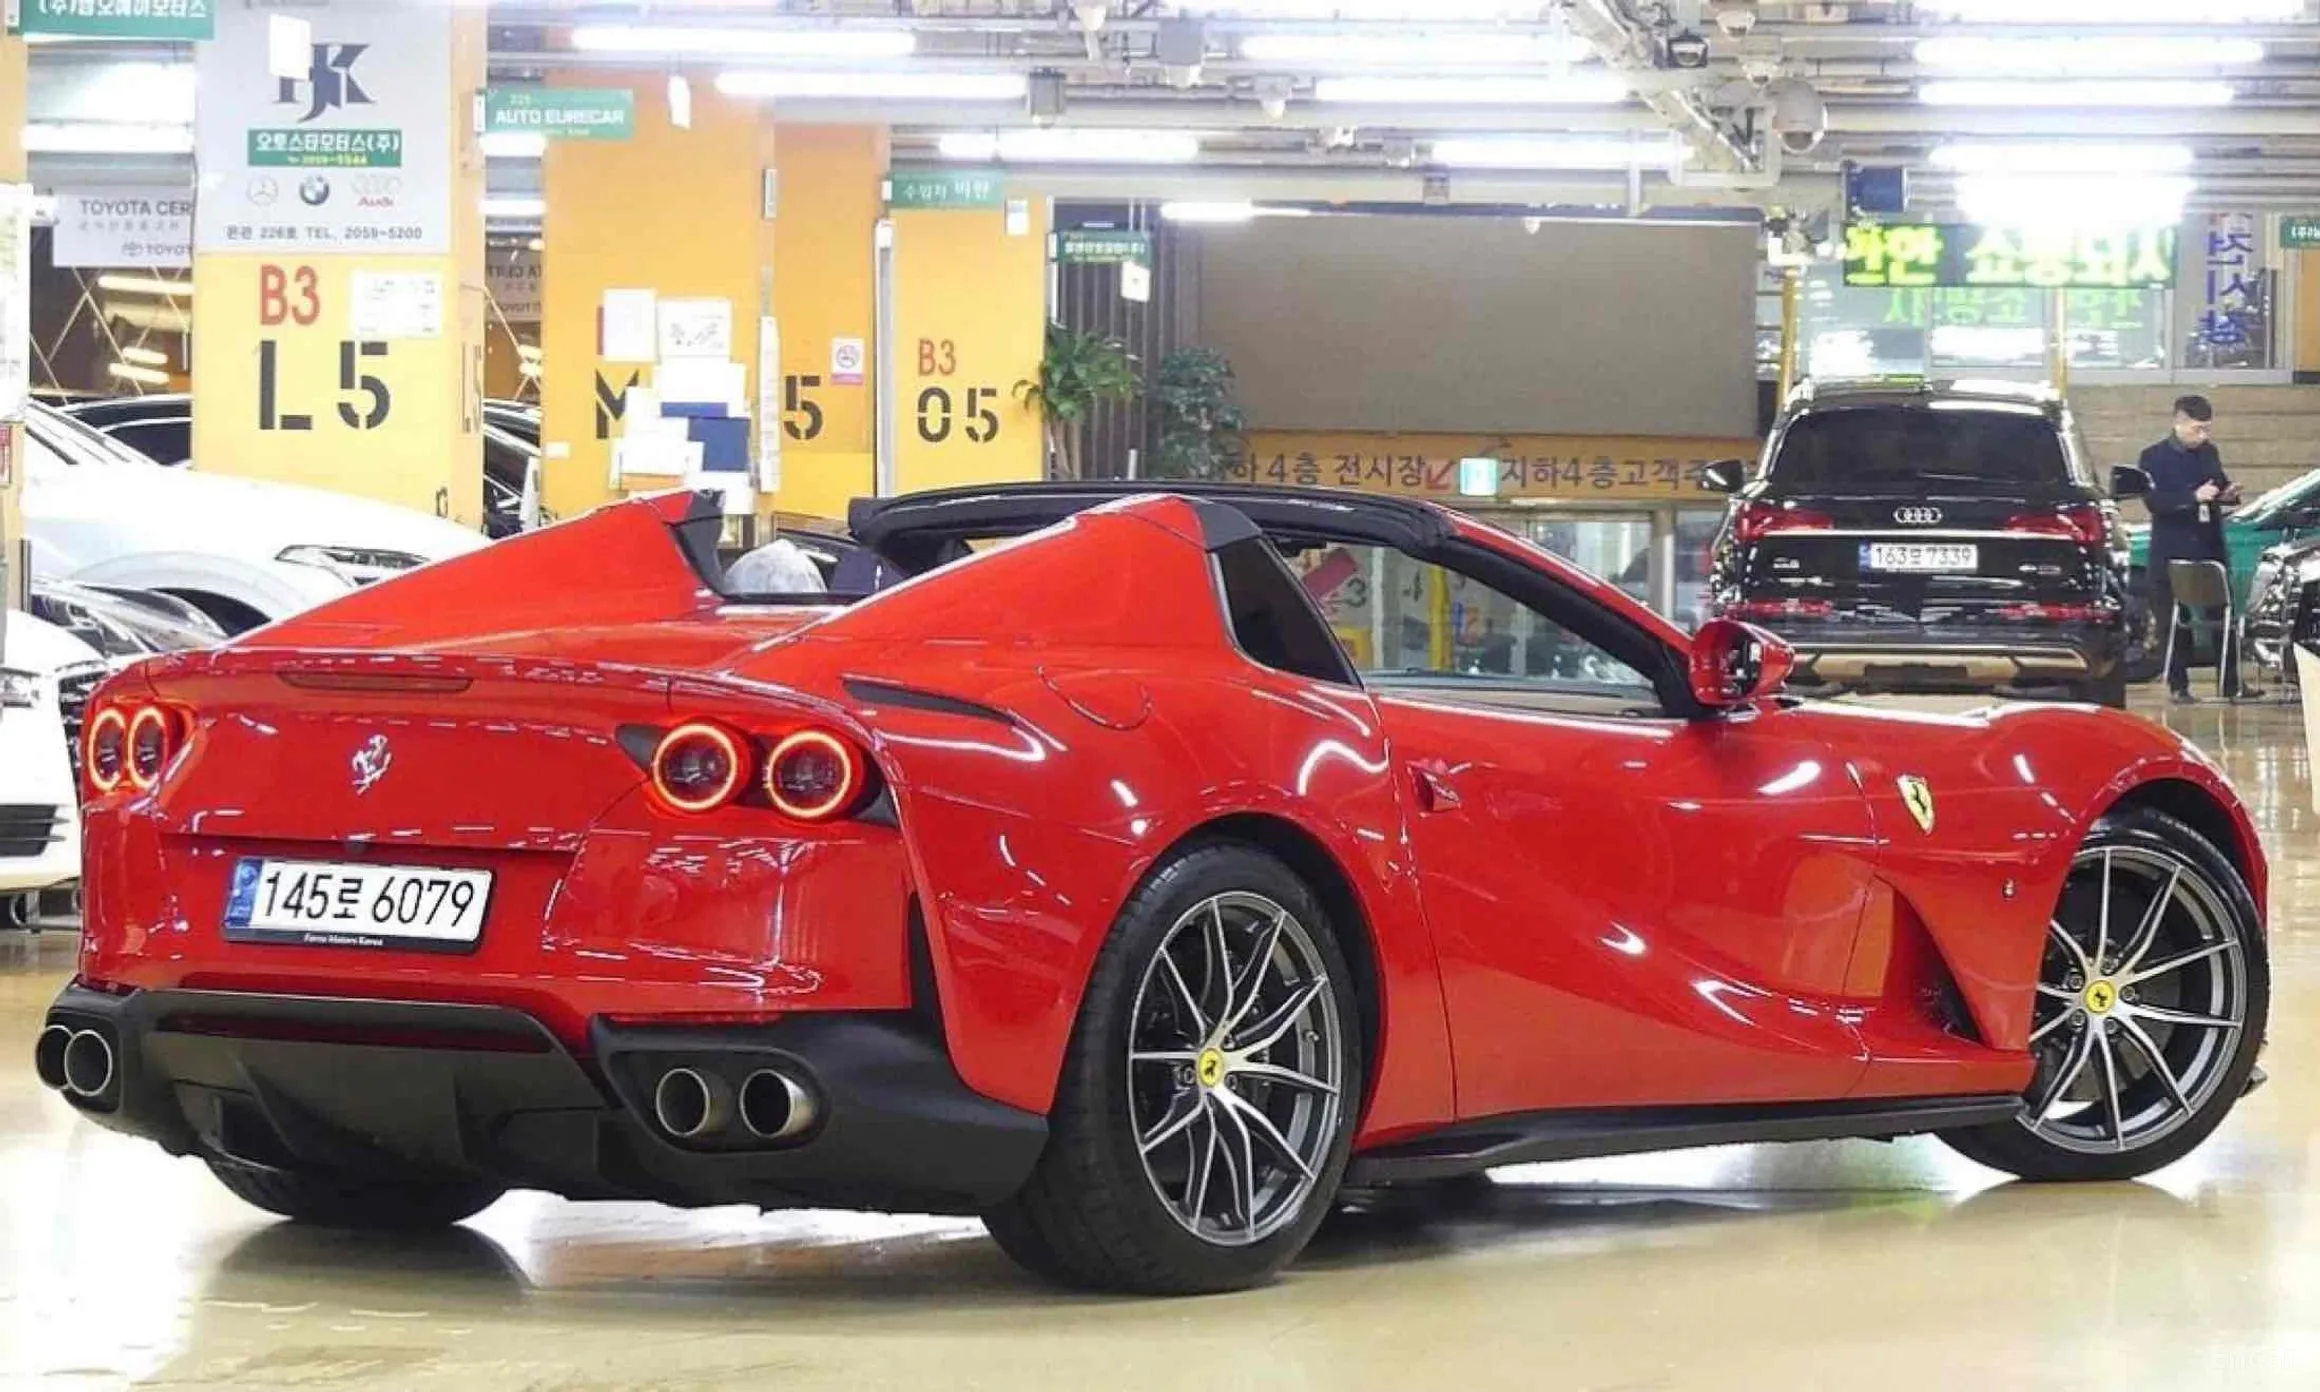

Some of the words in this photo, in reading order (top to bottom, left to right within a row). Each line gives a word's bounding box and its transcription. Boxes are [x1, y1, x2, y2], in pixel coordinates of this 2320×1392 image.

[495, 108, 541, 125] AUTO
[79, 199, 152, 216] TOYOTA
[356, 196, 395, 207] Audi
[259, 263, 321, 326] B3
[917, 338, 957, 376] B3
[264, 869, 364, 919] 145로
[370, 875, 475, 928] 6079
